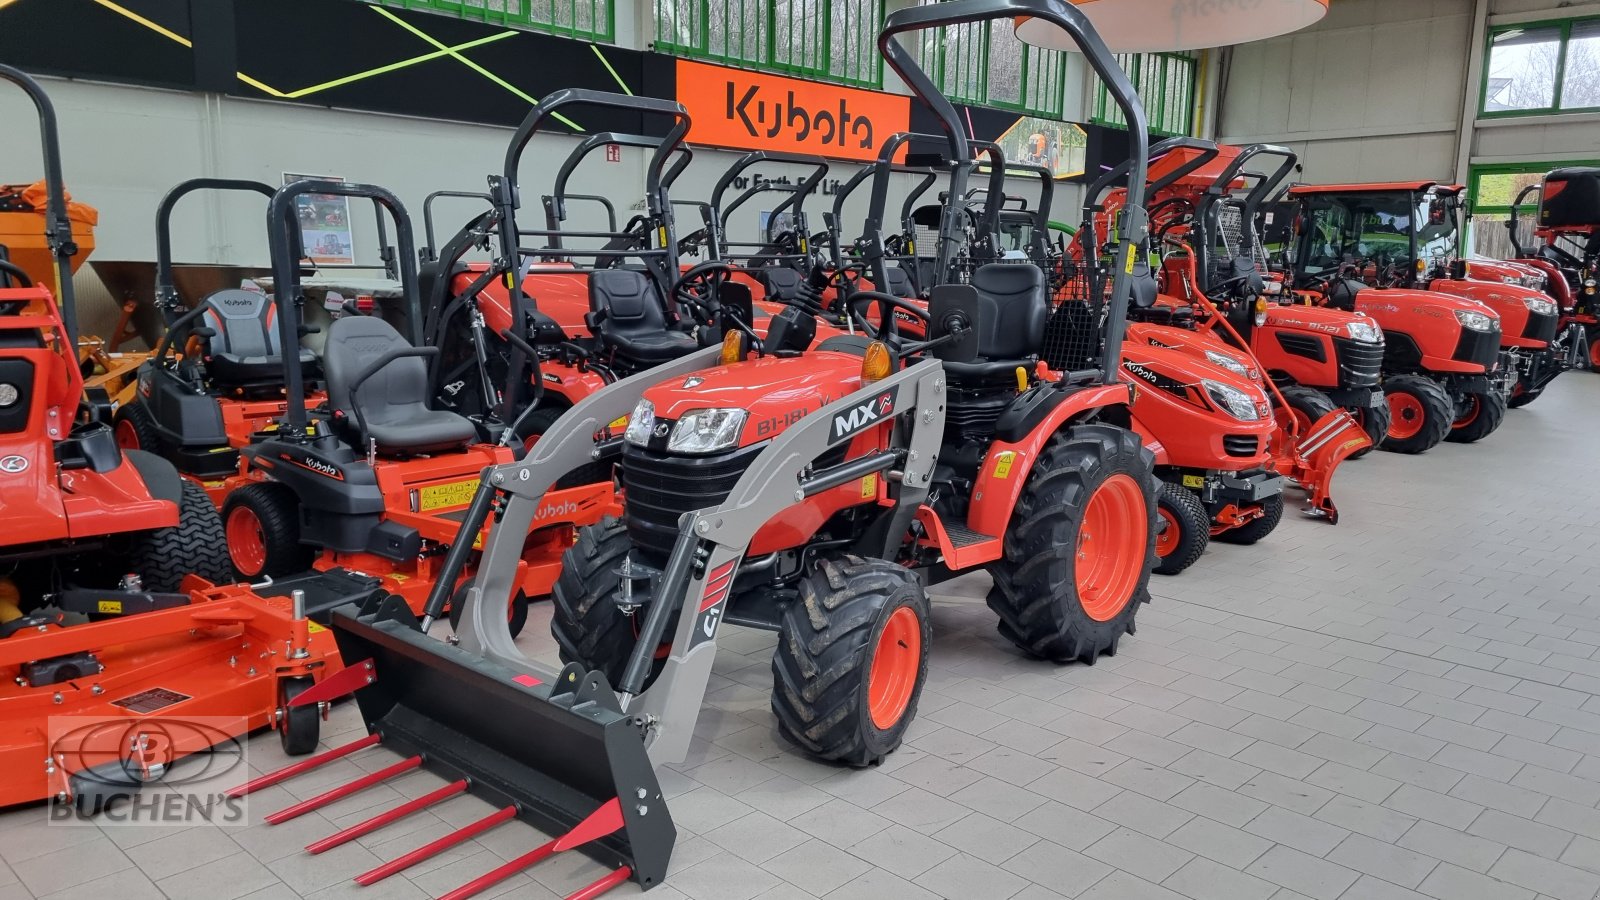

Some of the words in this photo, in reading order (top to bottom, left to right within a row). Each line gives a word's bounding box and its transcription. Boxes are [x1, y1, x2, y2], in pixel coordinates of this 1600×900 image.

[726, 81, 873, 149] Kubota
[728, 176, 749, 190] or
[224, 299, 253, 307] Kubota
[1308, 322, 1341, 334] B1-121
[1126, 361, 1157, 383] Kubota
[757, 407, 809, 436] B1-181
[835, 399, 878, 437] MX
[306, 457, 336, 476] Kubota
